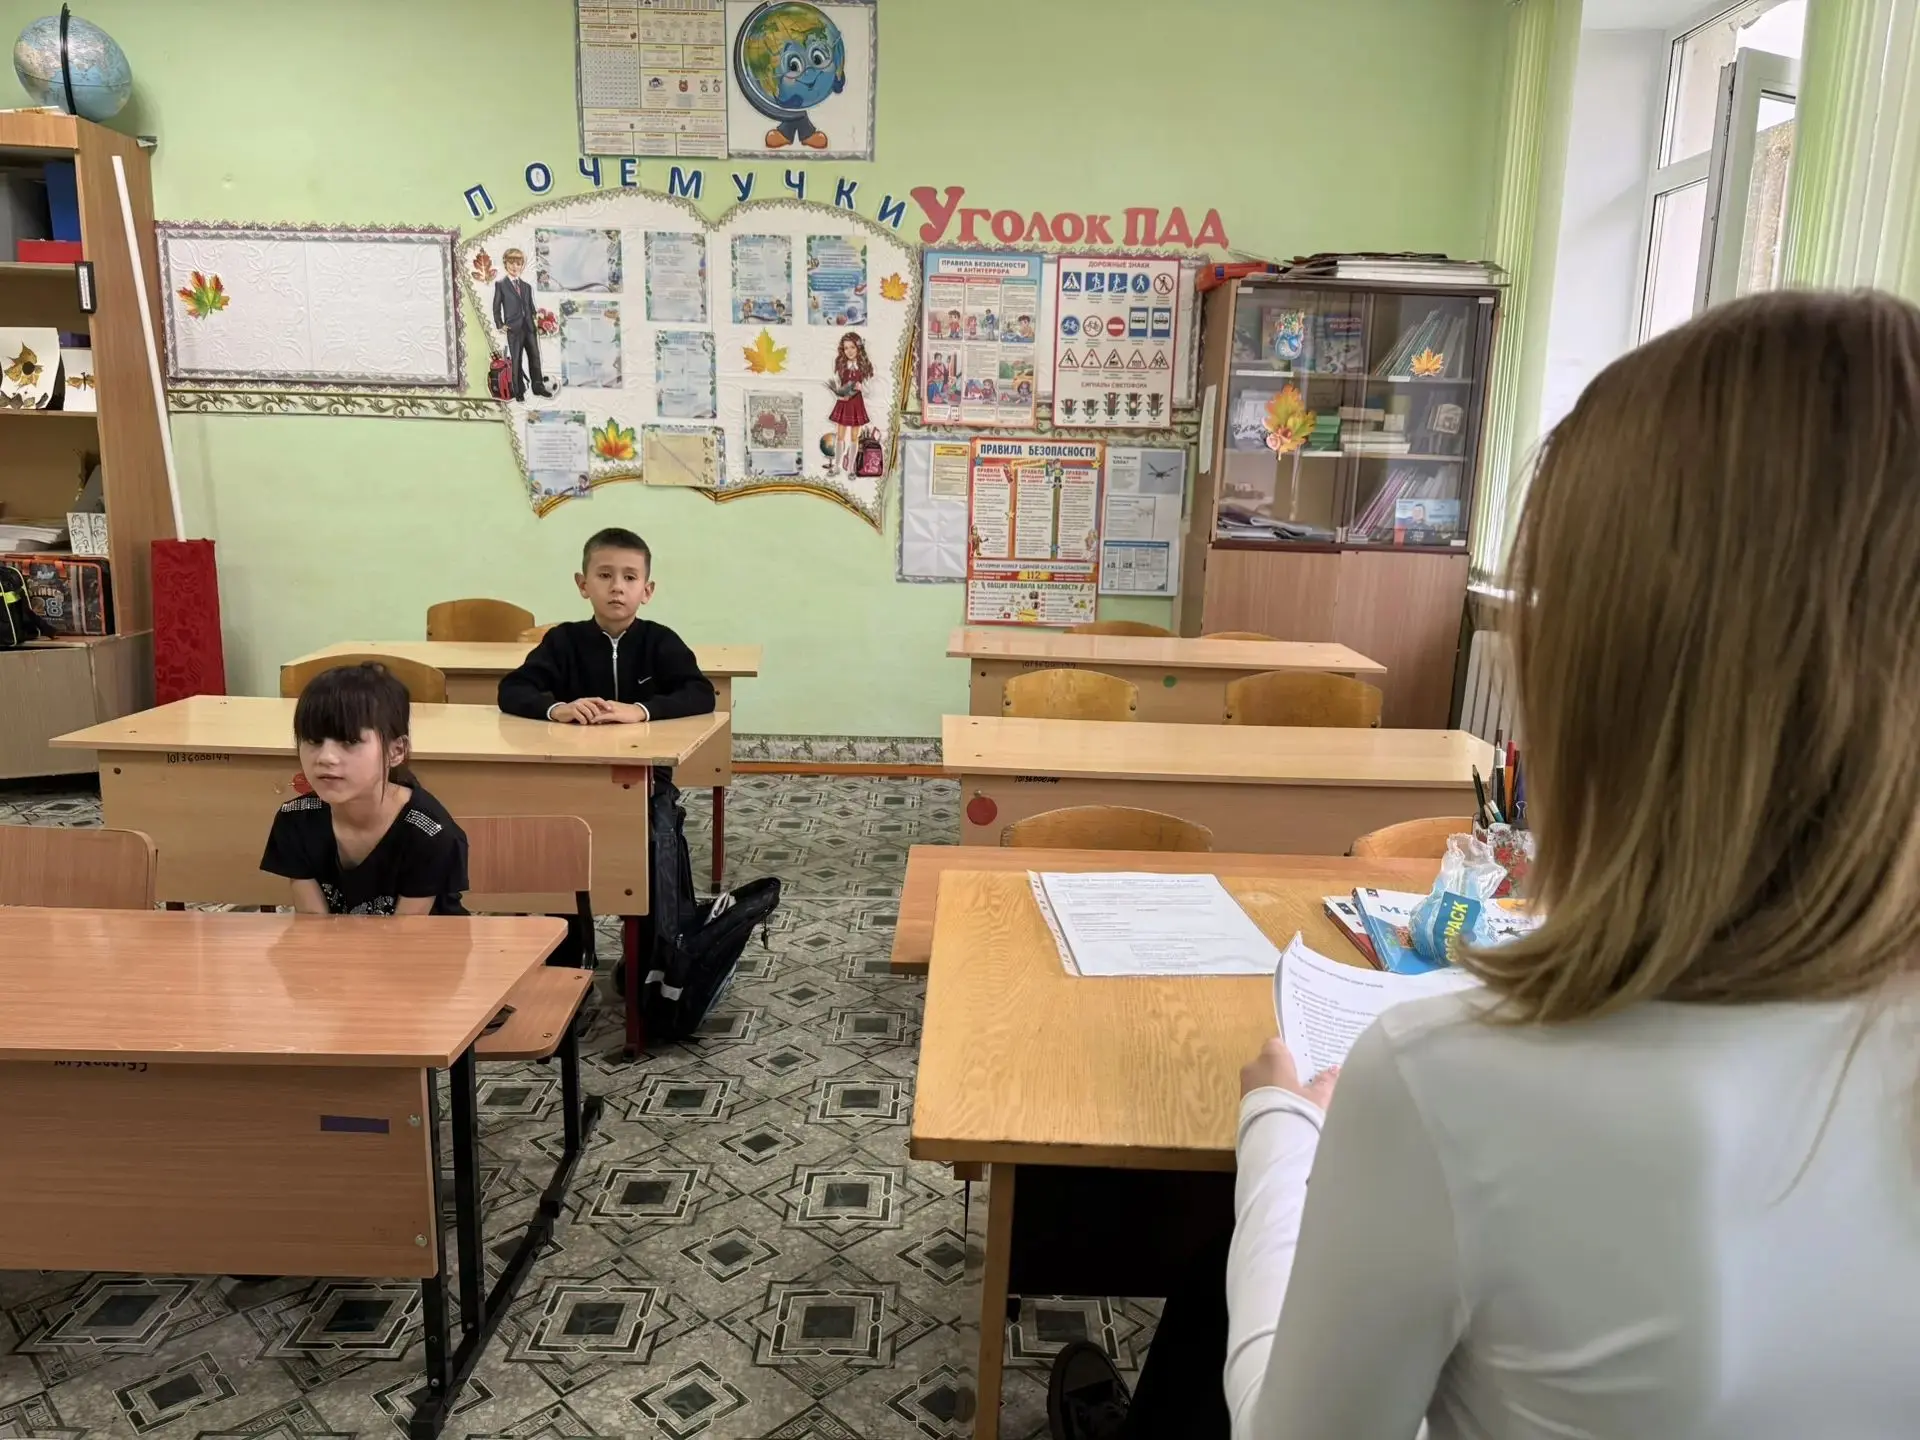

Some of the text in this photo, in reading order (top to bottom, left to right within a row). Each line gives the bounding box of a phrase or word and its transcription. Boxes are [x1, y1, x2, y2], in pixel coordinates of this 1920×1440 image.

[465, 159, 906, 227] ПОЧЕМУЧКИ
[1122, 206, 1229, 249] ПДД
[941, 259, 1026, 269] ПРАВИЛА БЕЗОПАСНОСТИ
[980, 444, 1096, 457] ПРАВИЛА БЕЗОПАСНОСТИ
[1026, 571, 1040, 579] 112
